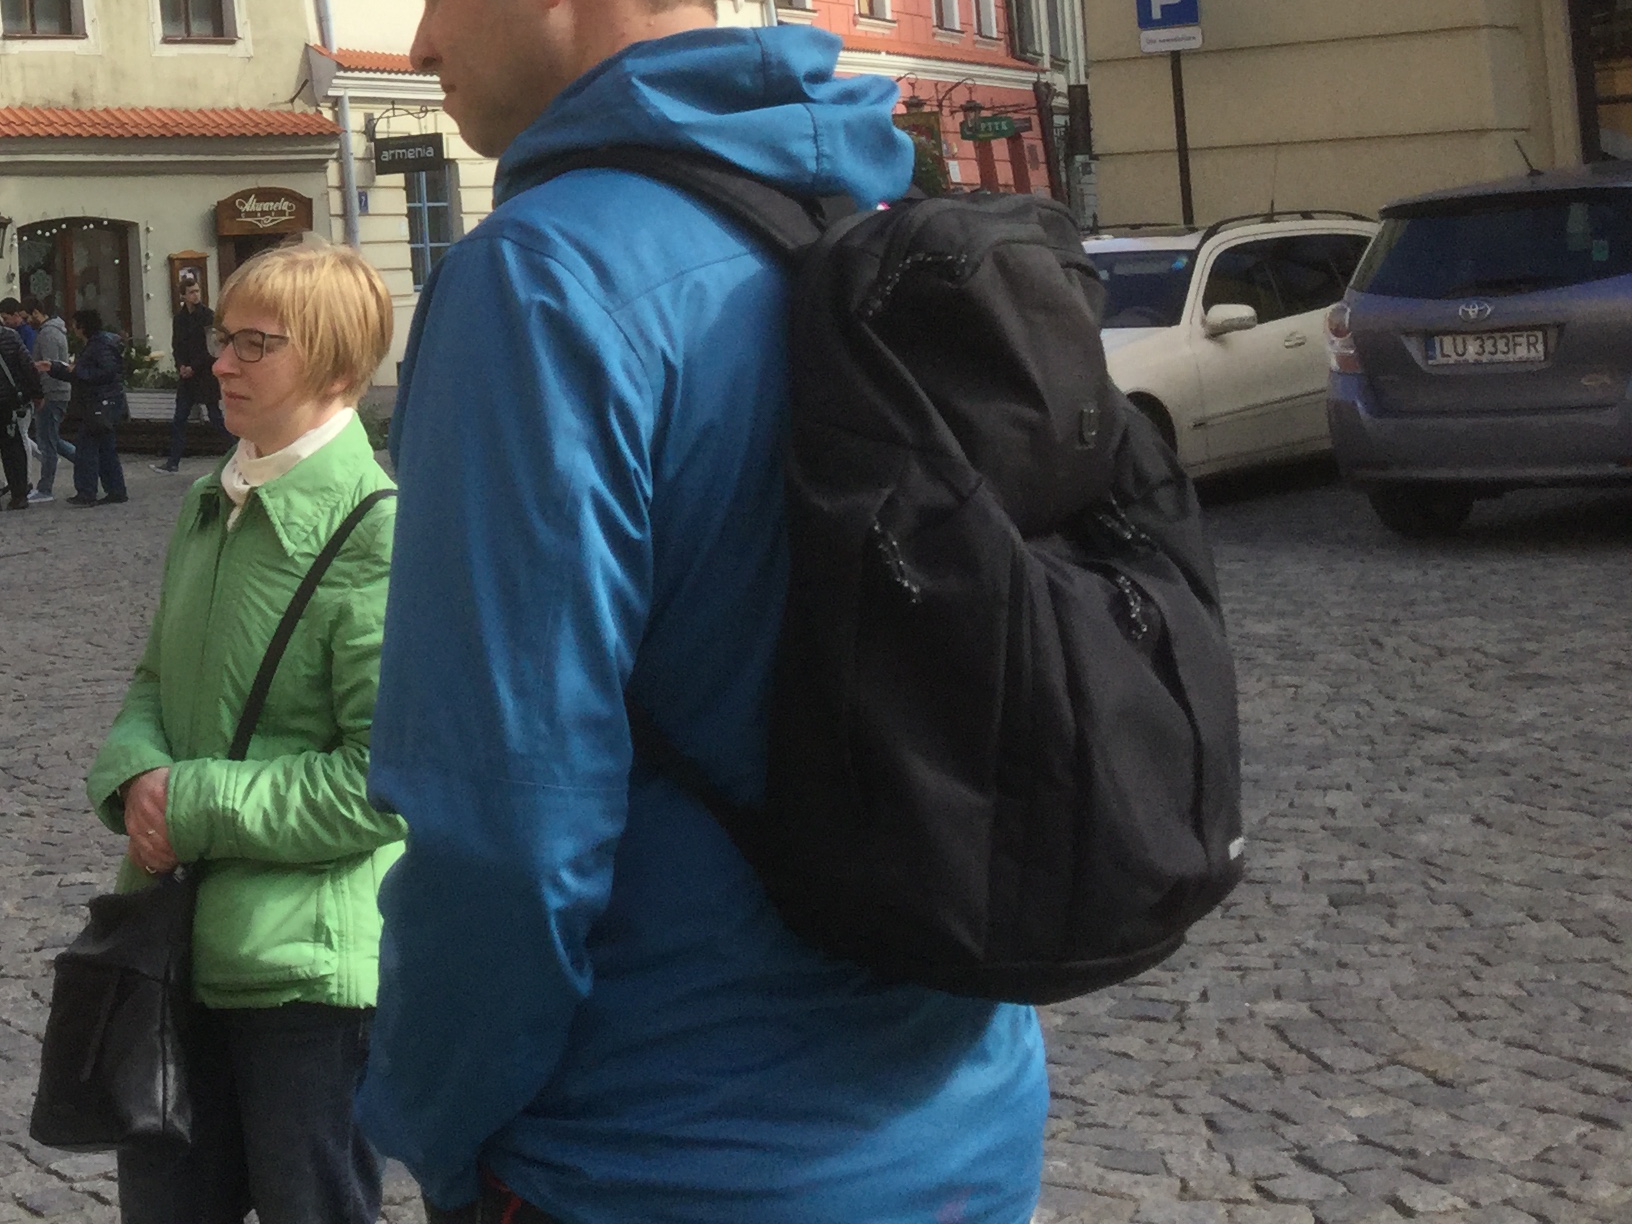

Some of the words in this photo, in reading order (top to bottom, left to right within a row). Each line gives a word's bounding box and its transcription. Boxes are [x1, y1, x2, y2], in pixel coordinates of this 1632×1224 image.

[380, 145, 435, 162] armenia
[1439, 336, 1468, 358] LU
[1474, 333, 1540, 356] 333FR
